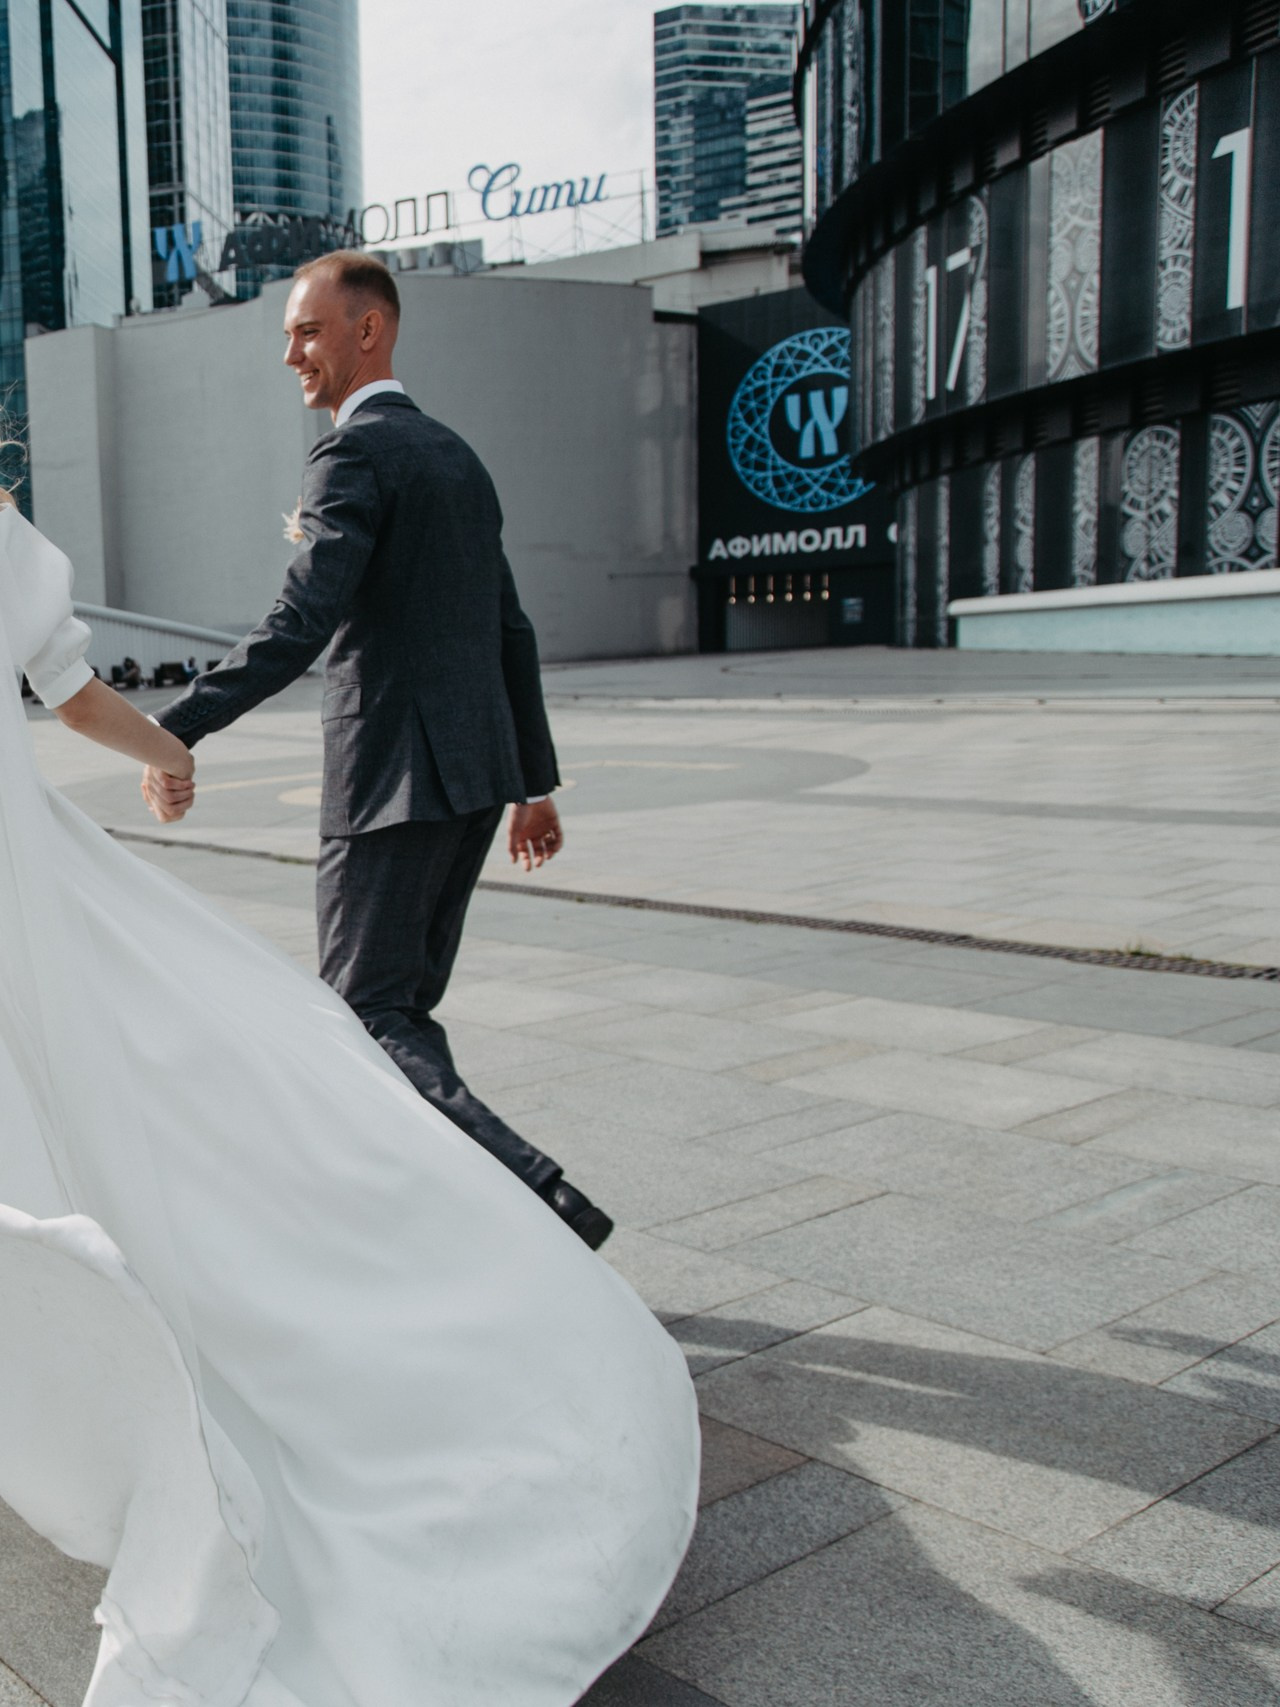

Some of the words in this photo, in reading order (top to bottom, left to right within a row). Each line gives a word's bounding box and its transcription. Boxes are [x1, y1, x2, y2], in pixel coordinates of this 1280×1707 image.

[468, 163, 608, 221] Сити
[925, 247, 977, 400] 17
[708, 524, 866, 561] АФИМОЛЛ
